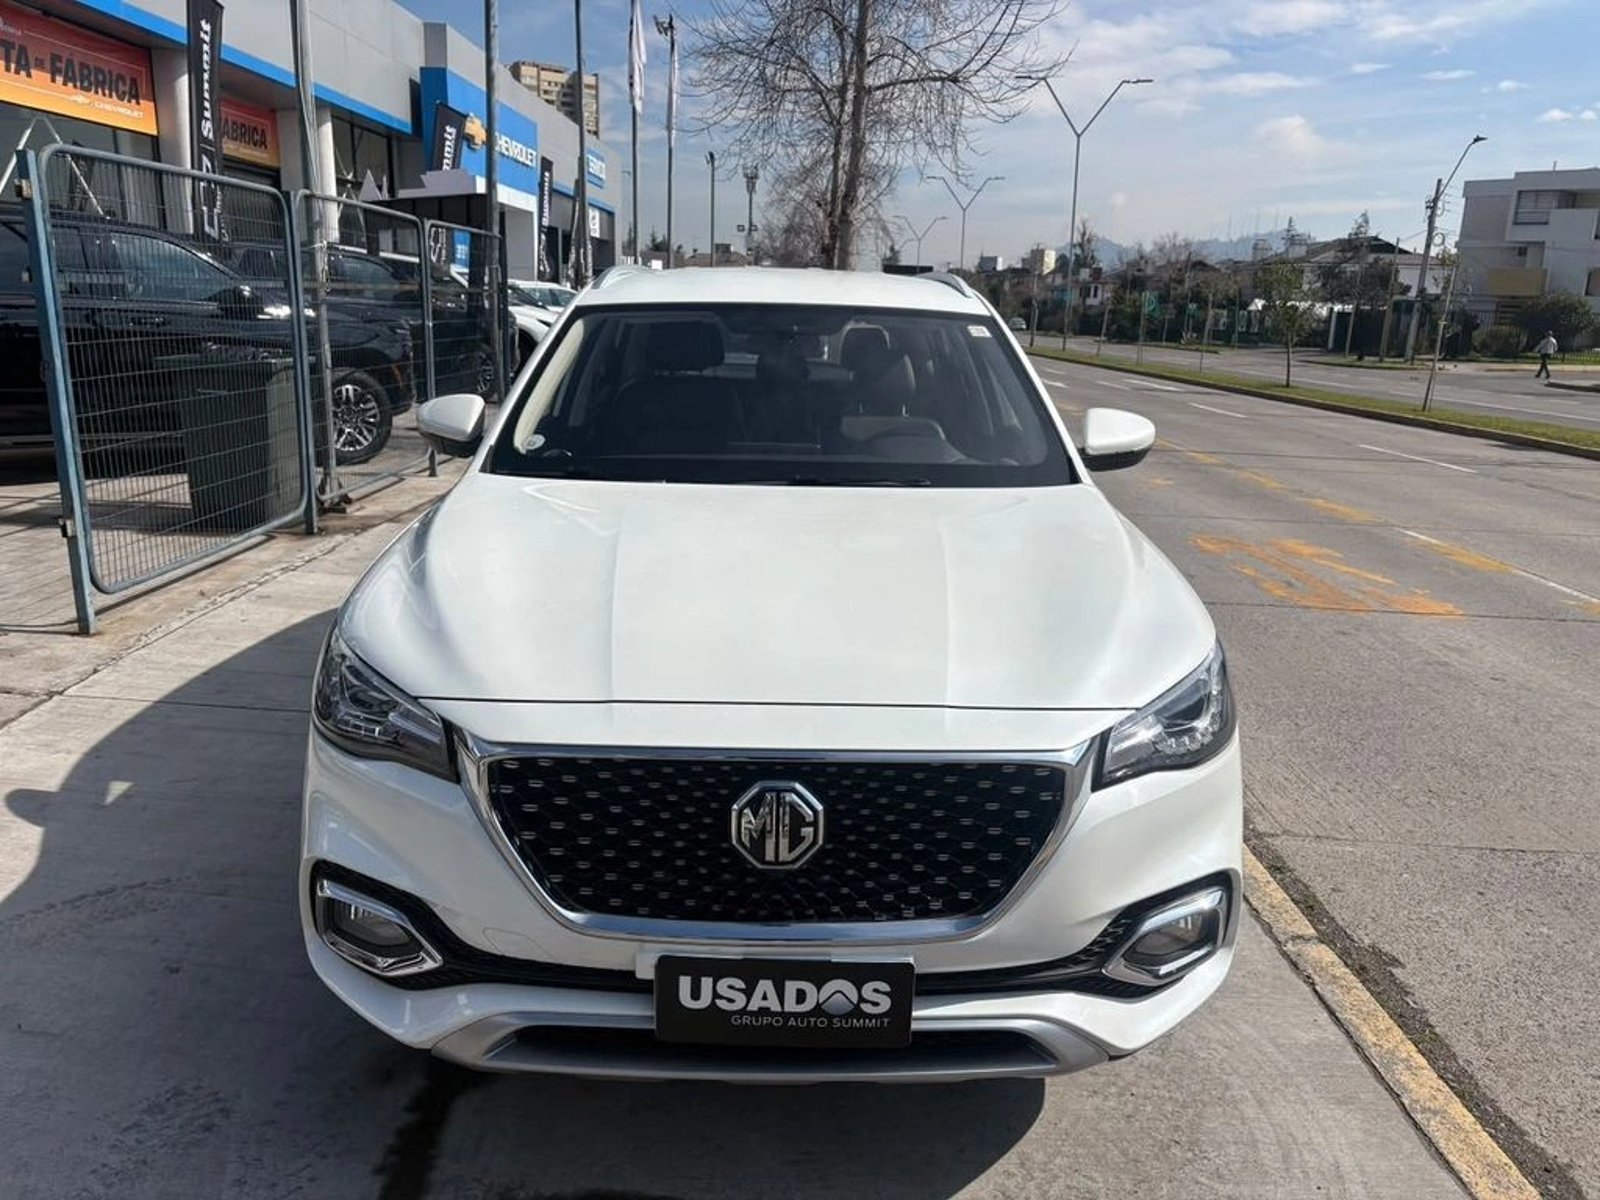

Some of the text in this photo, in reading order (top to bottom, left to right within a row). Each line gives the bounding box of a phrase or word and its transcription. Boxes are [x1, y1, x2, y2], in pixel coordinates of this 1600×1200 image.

[200, 19, 214, 141] Summit
[222, 118, 268, 150] ABRICA
[495, 131, 536, 168] HEVROLET
[741, 792, 814, 862] MG
[678, 975, 892, 1015] USADOS
[731, 1015, 890, 1028] GRUPO AUTO SUMMIT
